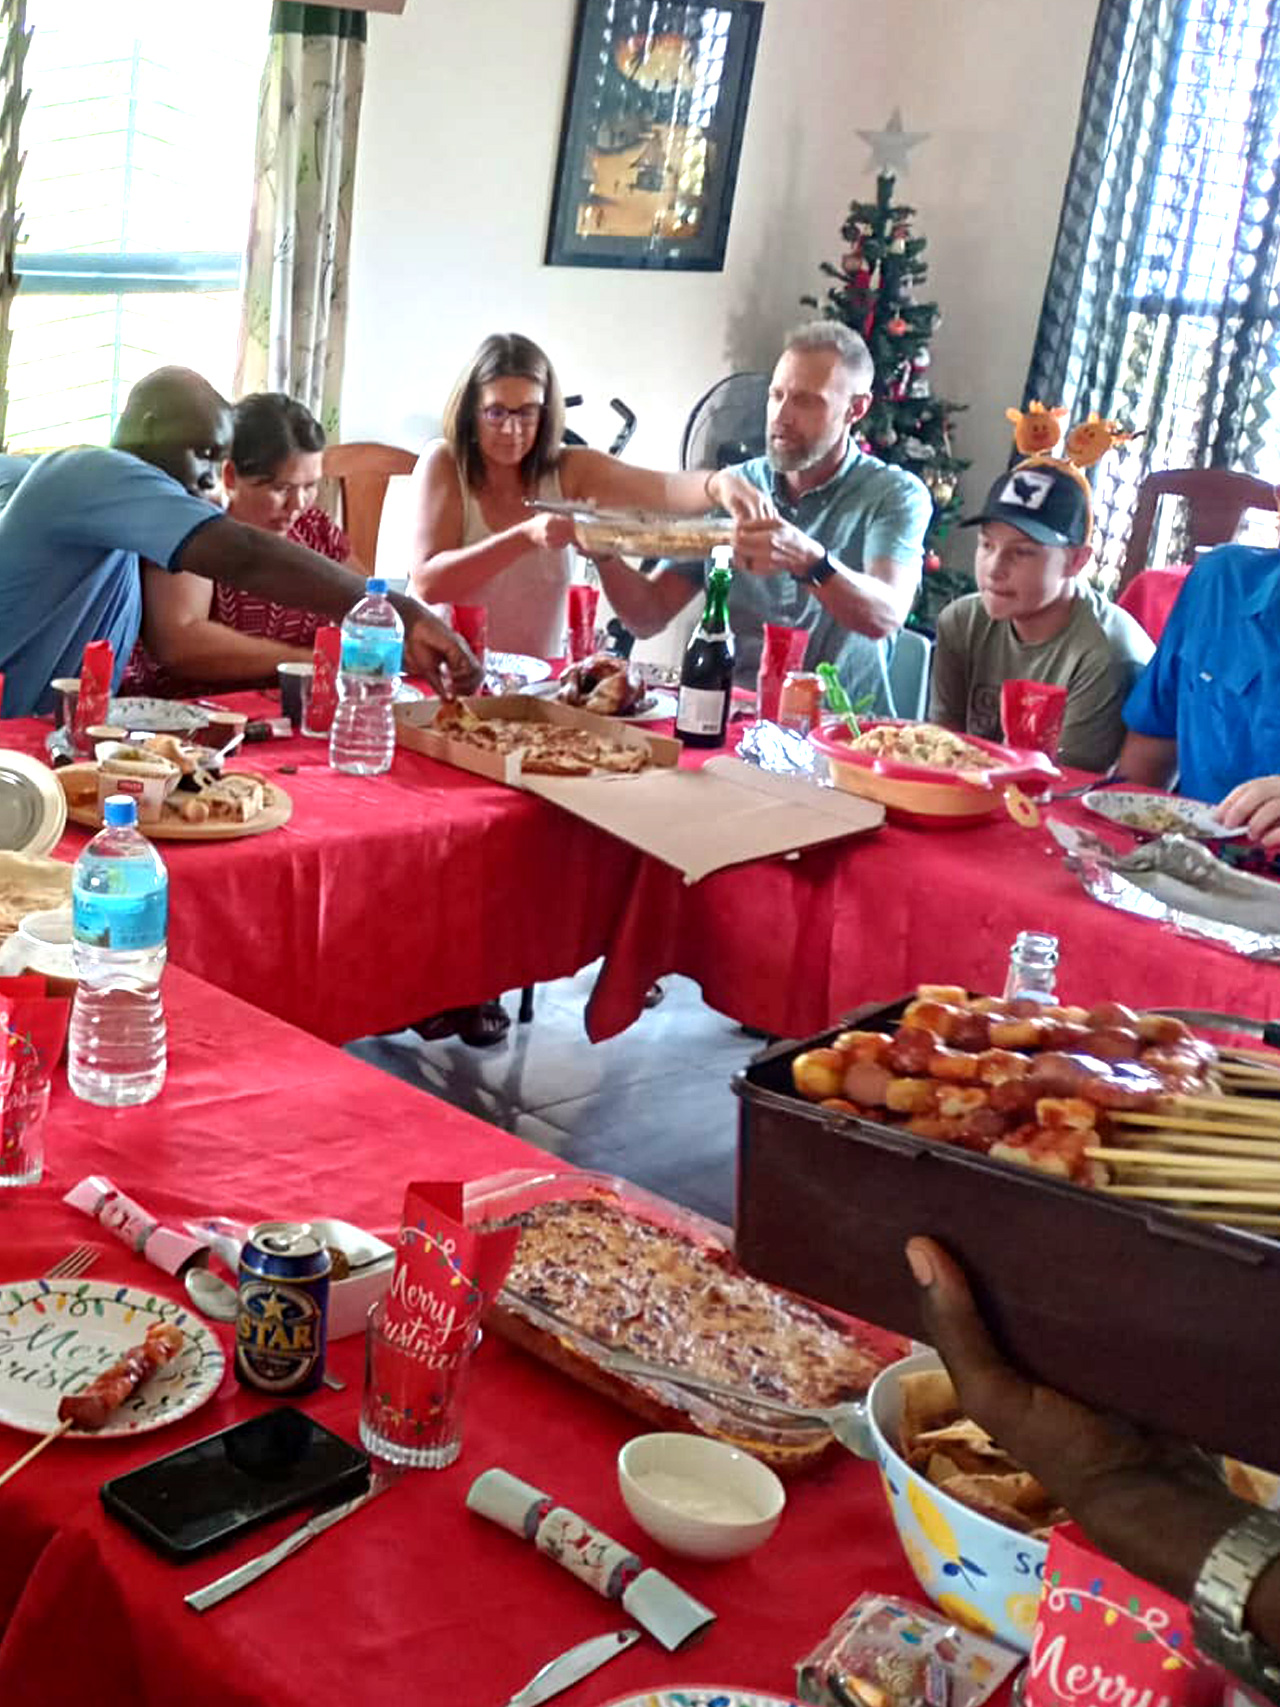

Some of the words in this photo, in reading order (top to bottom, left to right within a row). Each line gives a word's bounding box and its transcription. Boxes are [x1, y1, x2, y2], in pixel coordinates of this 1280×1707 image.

[238, 1311, 313, 1351] STAR
[391, 1262, 467, 1346] Merry
[1030, 1620, 1172, 1707] Merr
